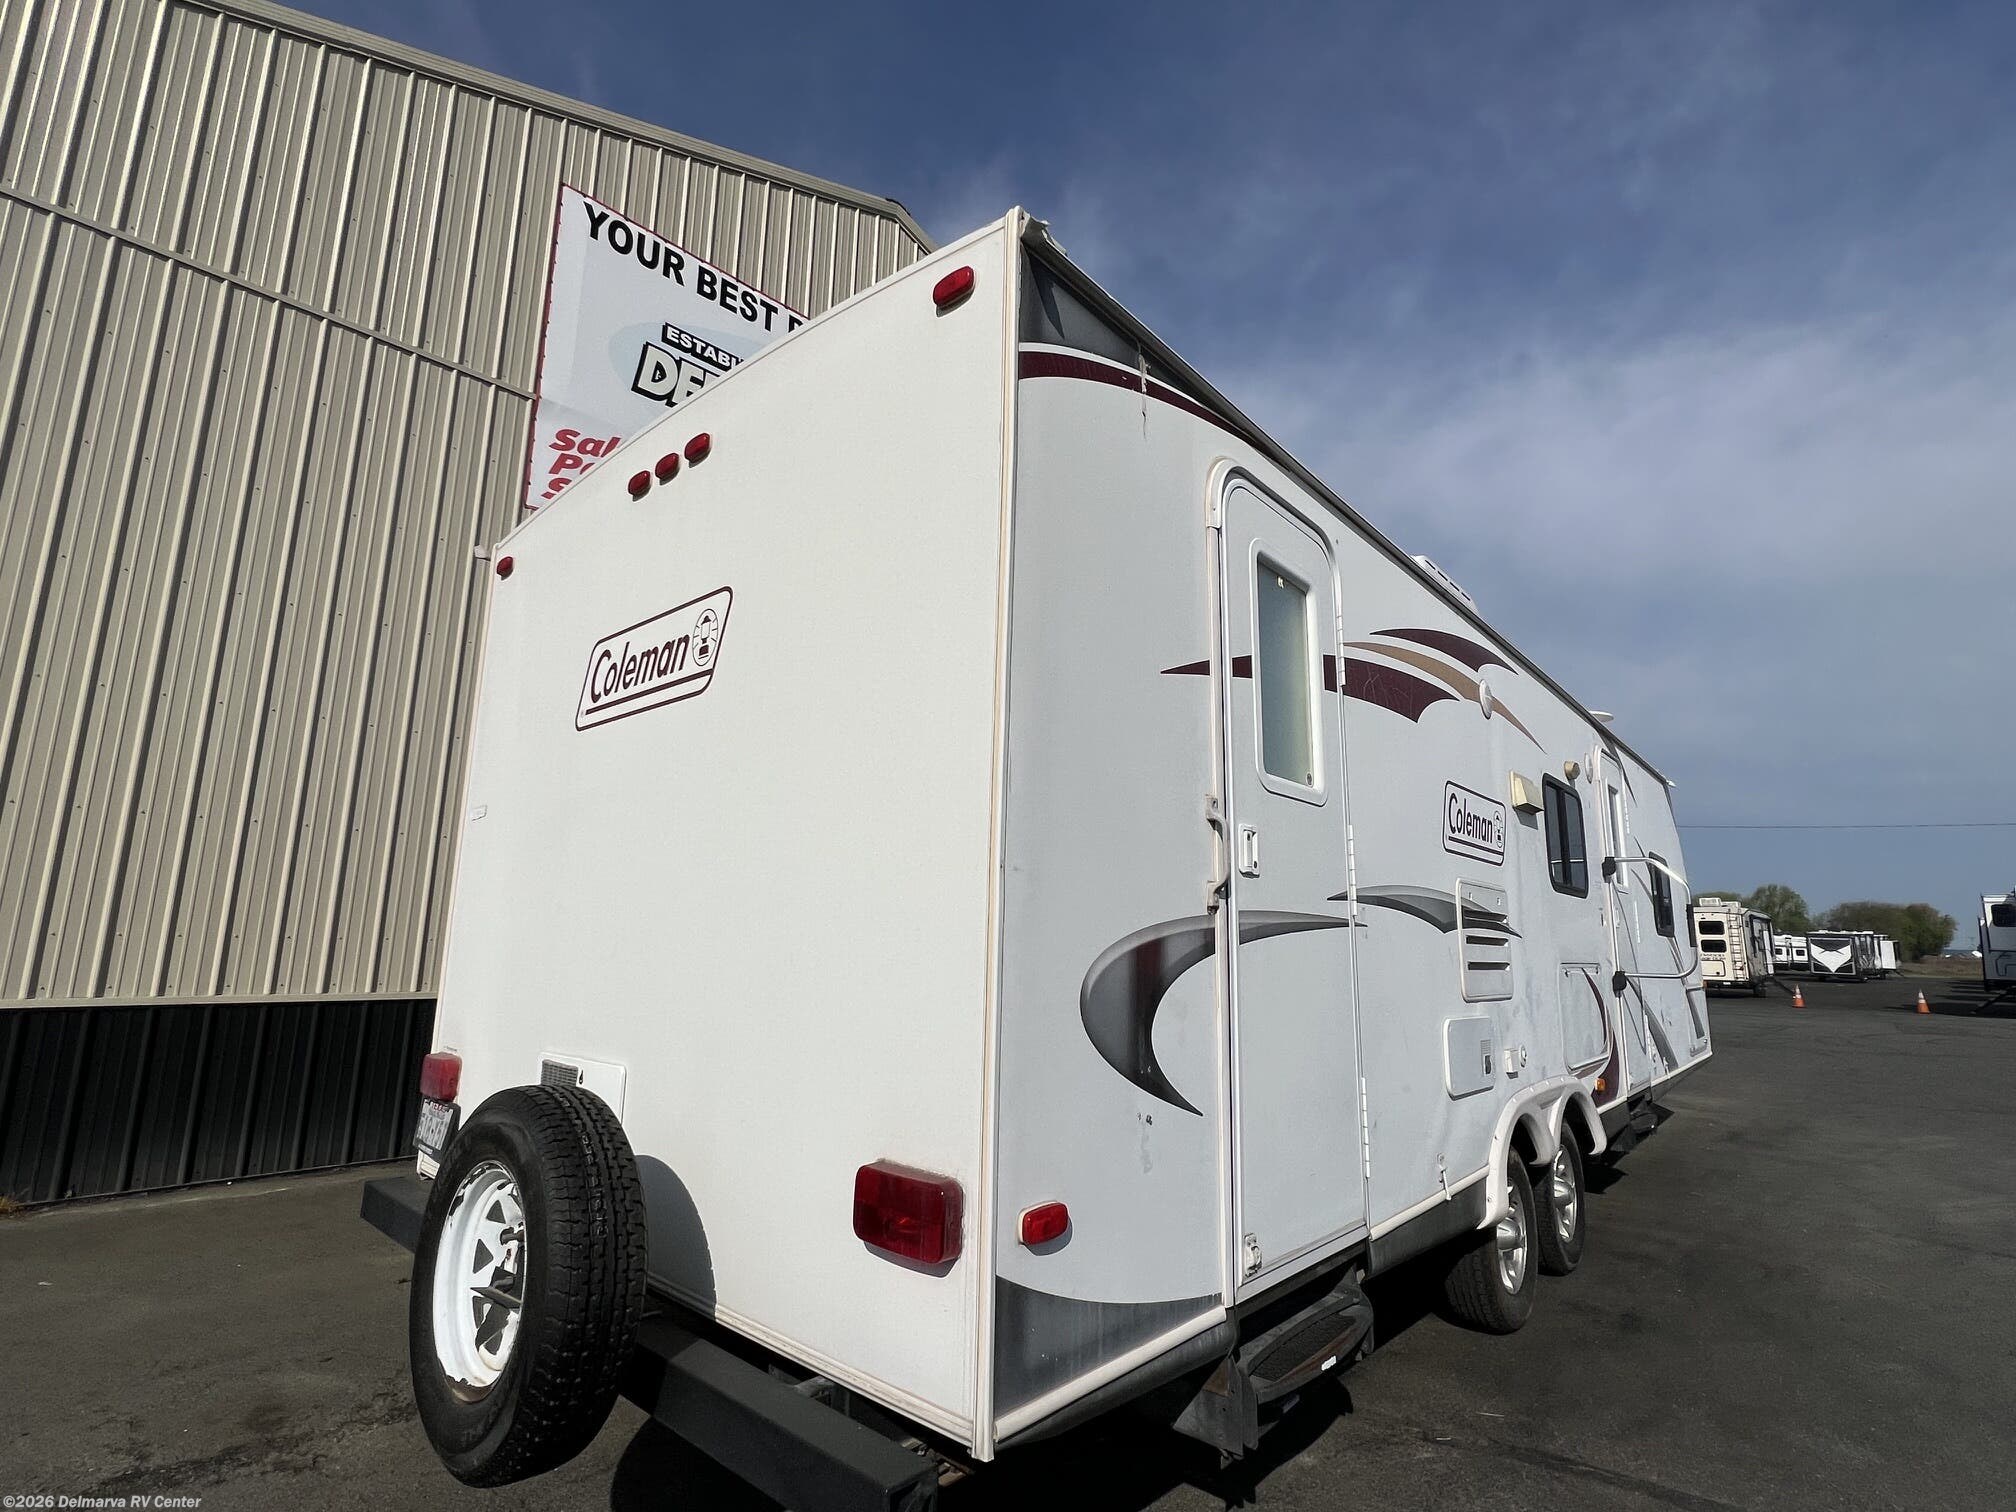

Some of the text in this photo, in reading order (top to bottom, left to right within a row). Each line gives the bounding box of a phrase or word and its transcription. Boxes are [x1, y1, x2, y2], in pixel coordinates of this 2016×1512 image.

[583, 201, 779, 333] YOUR BEST
[590, 634, 691, 704] Coleman
[1448, 792, 1493, 844] Coleman
